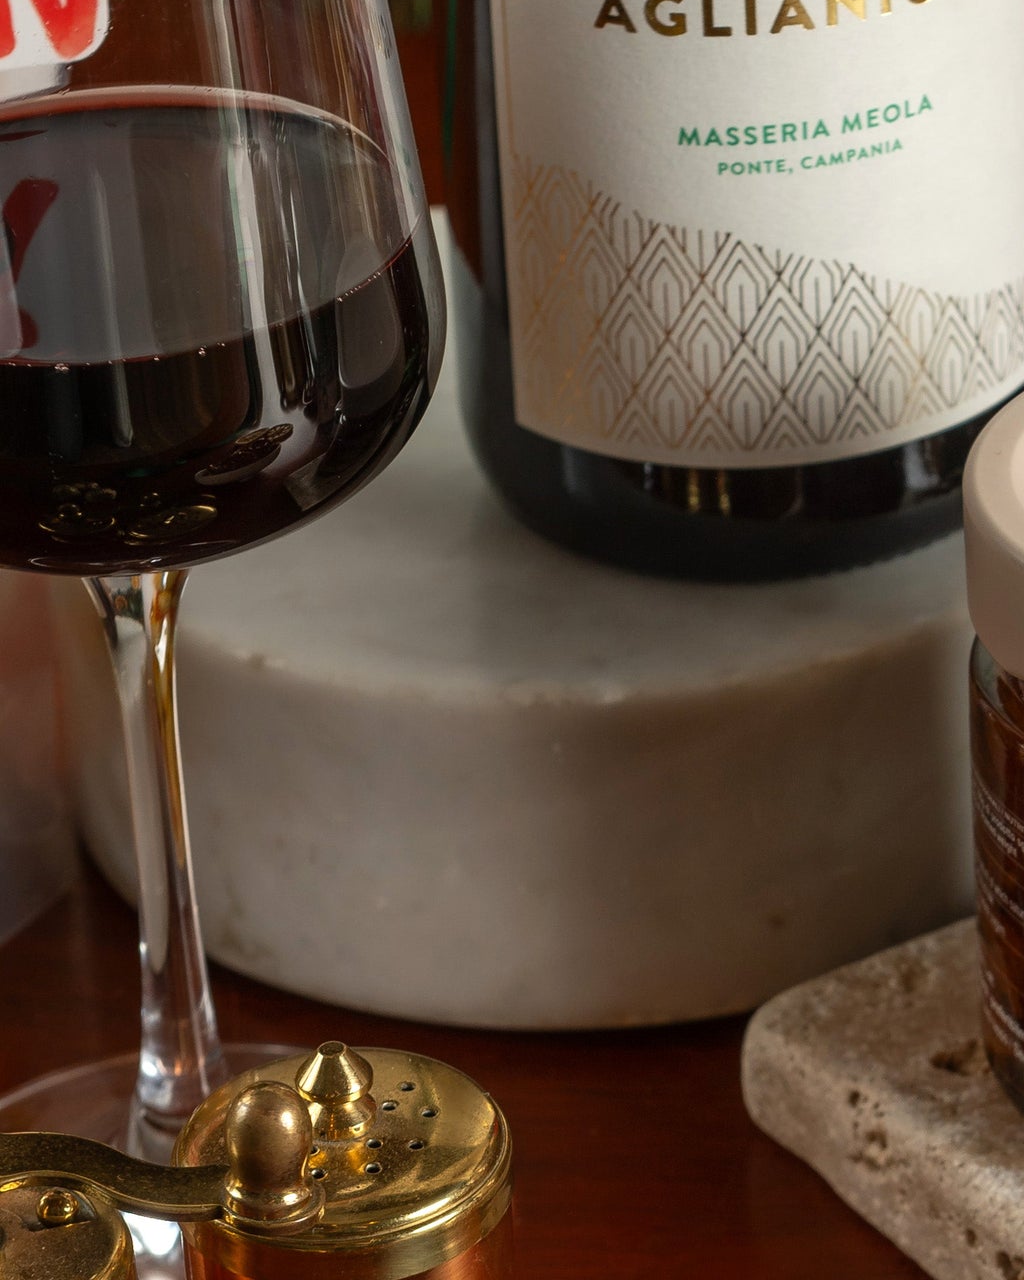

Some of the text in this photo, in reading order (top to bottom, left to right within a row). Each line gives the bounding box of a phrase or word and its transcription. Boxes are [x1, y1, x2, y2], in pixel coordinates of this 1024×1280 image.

[677, 94, 934, 147] MASSERIA MEOLA
[717, 138, 904, 176] PONTE, CAMPANIA
